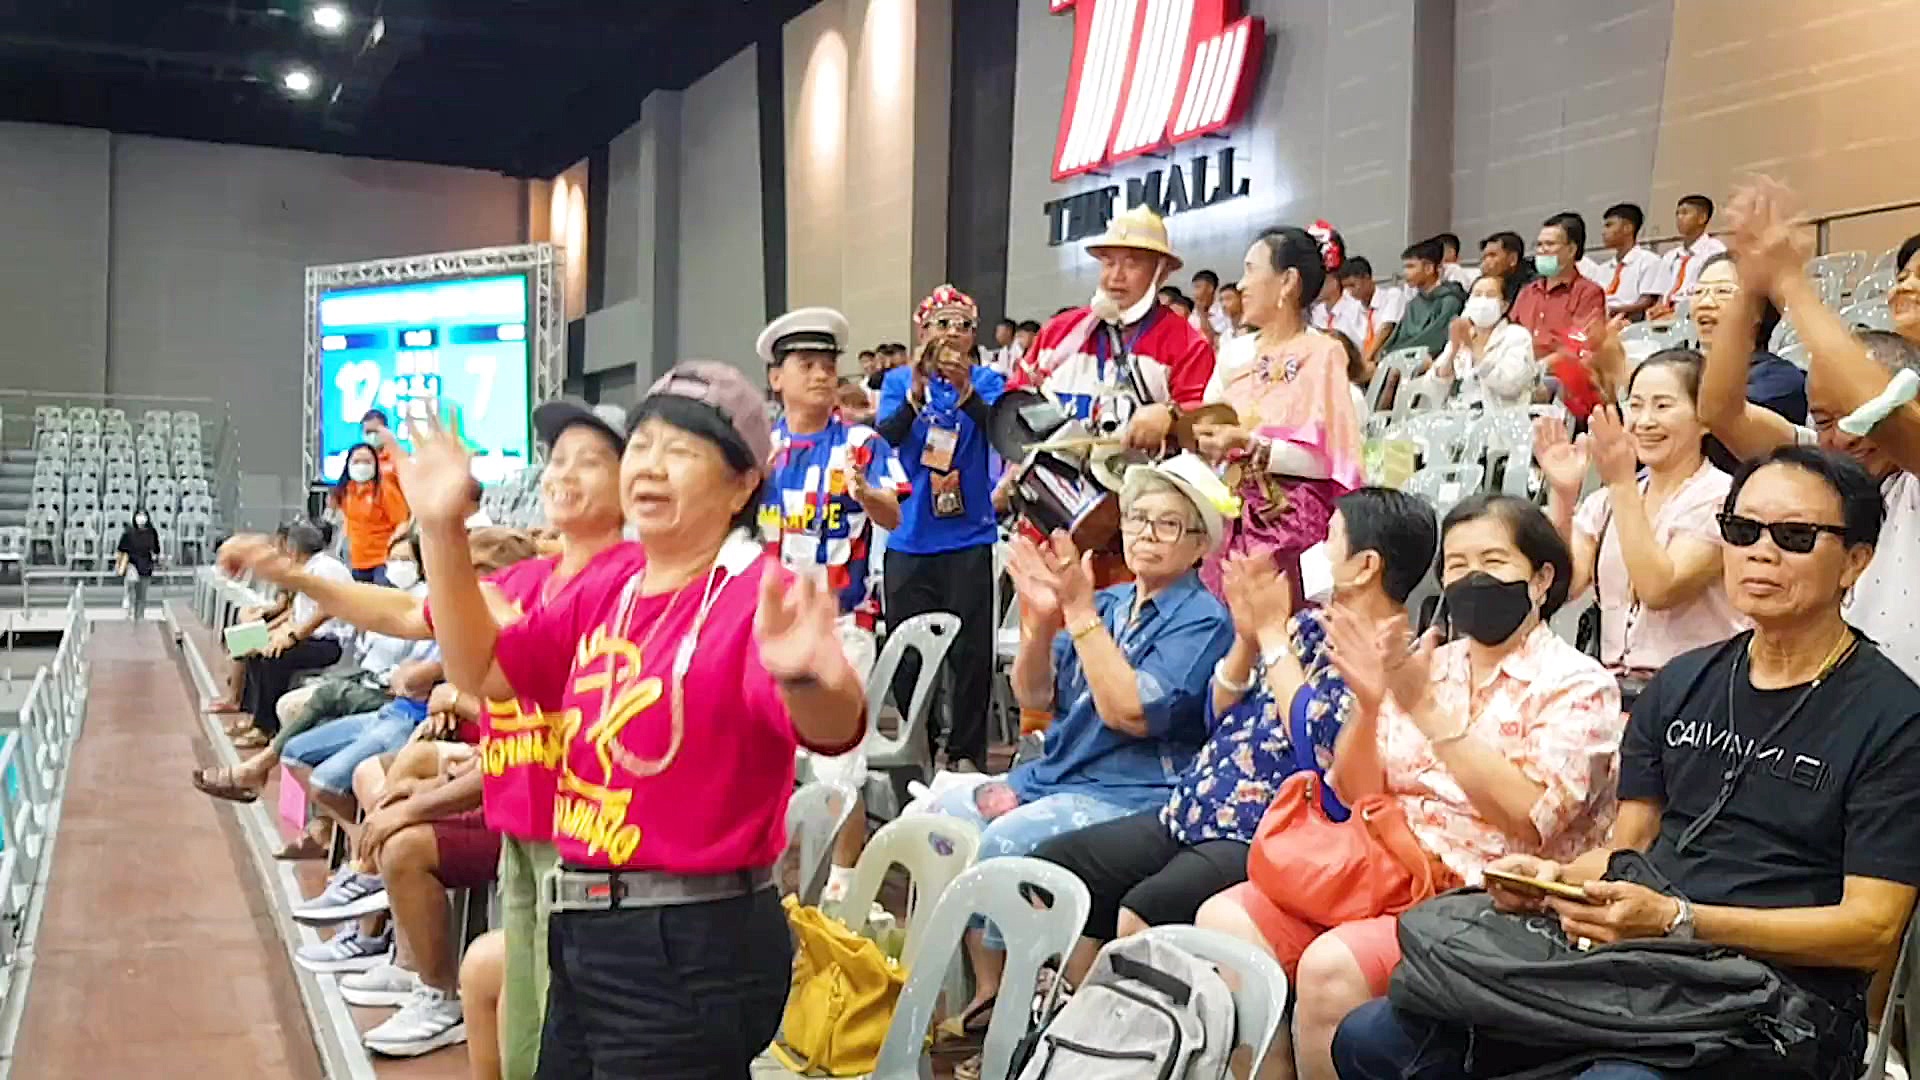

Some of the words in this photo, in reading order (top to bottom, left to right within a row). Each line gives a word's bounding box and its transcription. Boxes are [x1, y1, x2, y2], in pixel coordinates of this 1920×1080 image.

[1044, 185, 1120, 246] THE
[1126, 147, 1251, 217] MALL
[465, 355, 498, 420] 7
